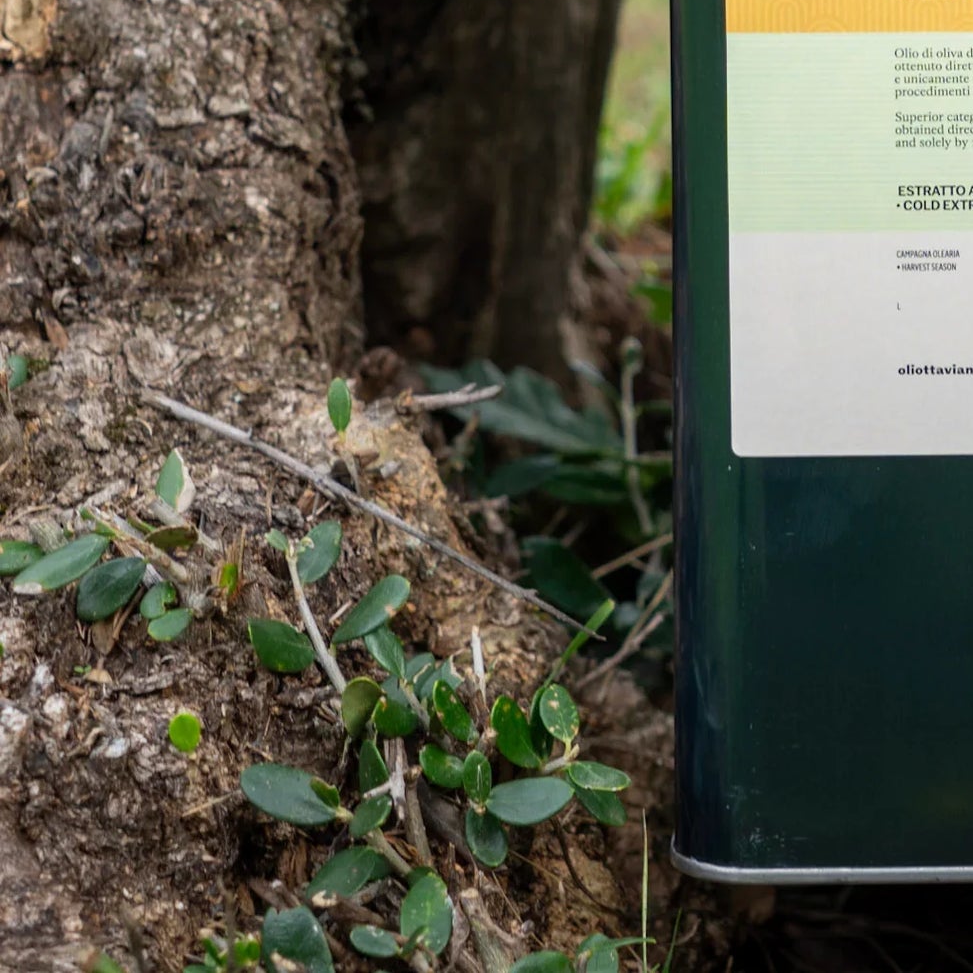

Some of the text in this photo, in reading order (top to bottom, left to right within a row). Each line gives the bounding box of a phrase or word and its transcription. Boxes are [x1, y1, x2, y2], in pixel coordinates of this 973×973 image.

[894, 48, 919, 59] Olio
[922, 48, 933, 59] di
[936, 48, 963, 58] oliva
[894, 61, 942, 71] ottenuto
[894, 76, 900, 84] e
[904, 74, 969, 84] unicamente
[895, 86, 970, 99] procedimenti
[895, 112, 944, 124] Superior
[895, 125, 945, 135] obtained
[895, 137, 916, 148] and
[920, 137, 951, 150] solely
[955, 137, 968, 149] by
[898, 186, 966, 197] ESTRATTO
[903, 200, 940, 211] COLD
[897, 250, 960, 259] CAMPAGNA OLEARIA
[902, 263, 957, 271] HARVEST SEASON
